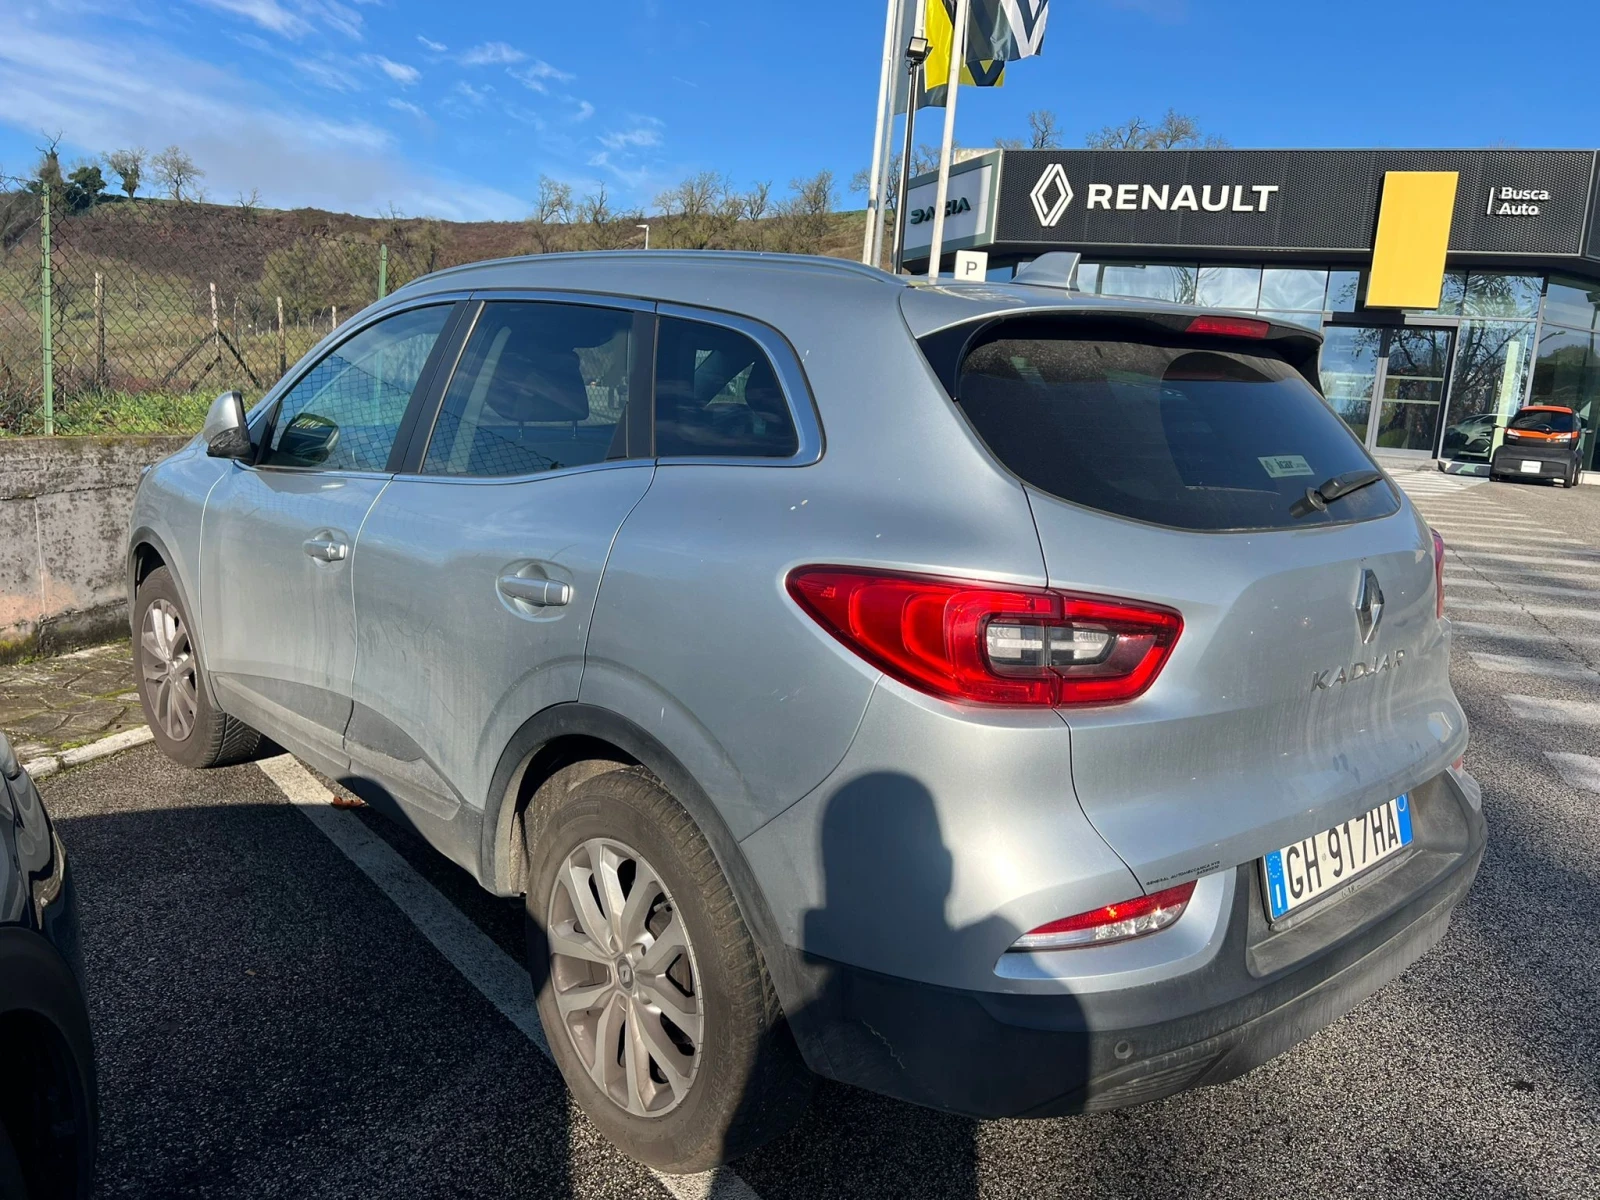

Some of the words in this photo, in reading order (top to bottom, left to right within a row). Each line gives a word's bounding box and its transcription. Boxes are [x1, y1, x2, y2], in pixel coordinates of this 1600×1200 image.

[1087, 183, 1279, 212] RENAULT
[1500, 186, 1549, 200] Busca
[1498, 202, 1539, 215] Auto
[965, 261, 978, 276] P
[1310, 649, 1405, 692] KADJAR
